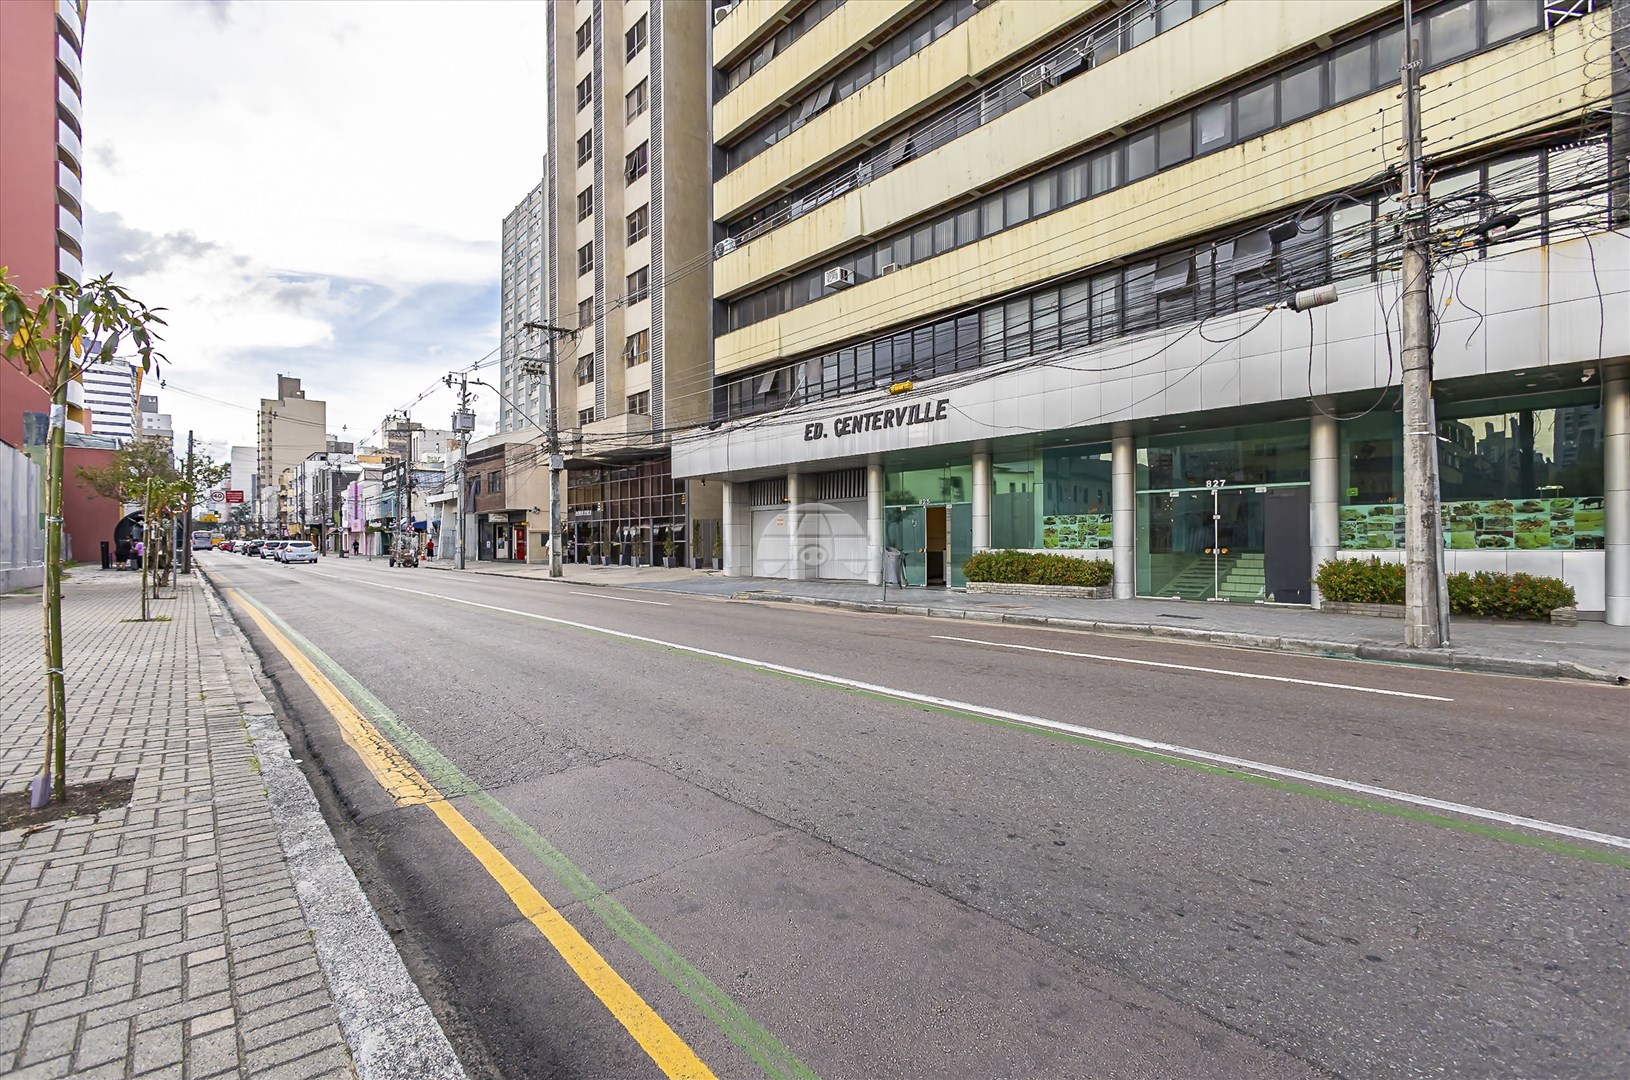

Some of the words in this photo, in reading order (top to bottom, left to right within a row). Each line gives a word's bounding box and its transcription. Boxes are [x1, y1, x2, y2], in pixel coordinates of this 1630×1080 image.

[804, 422, 828, 441] ED.
[834, 399, 949, 438] CENTERVILLE
[1205, 479, 1226, 488] 827
